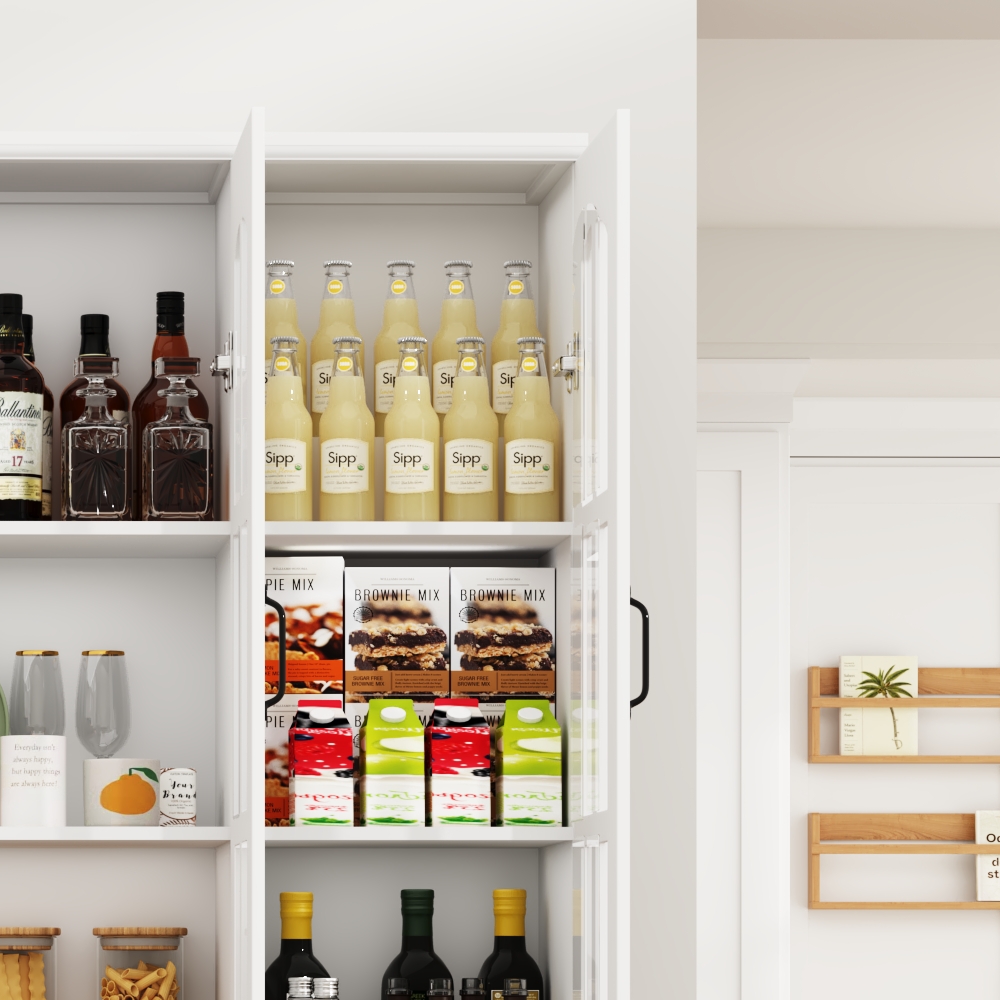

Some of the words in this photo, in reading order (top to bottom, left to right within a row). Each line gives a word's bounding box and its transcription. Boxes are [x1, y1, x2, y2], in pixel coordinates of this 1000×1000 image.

[11, 455, 23, 467] 17
[265, 451, 294, 468] Sipp
[328, 451, 357, 468] Sipp
[393, 451, 422, 468] Sipp
[452, 451, 481, 468] Sipp
[513, 451, 542, 468] Sipp
[292, 578, 314, 591] MIX
[354, 588, 411, 601] BROWNIE
[418, 588, 440, 601] MIX
[460, 588, 517, 602] BROWNIE
[523, 588, 546, 602] MIX
